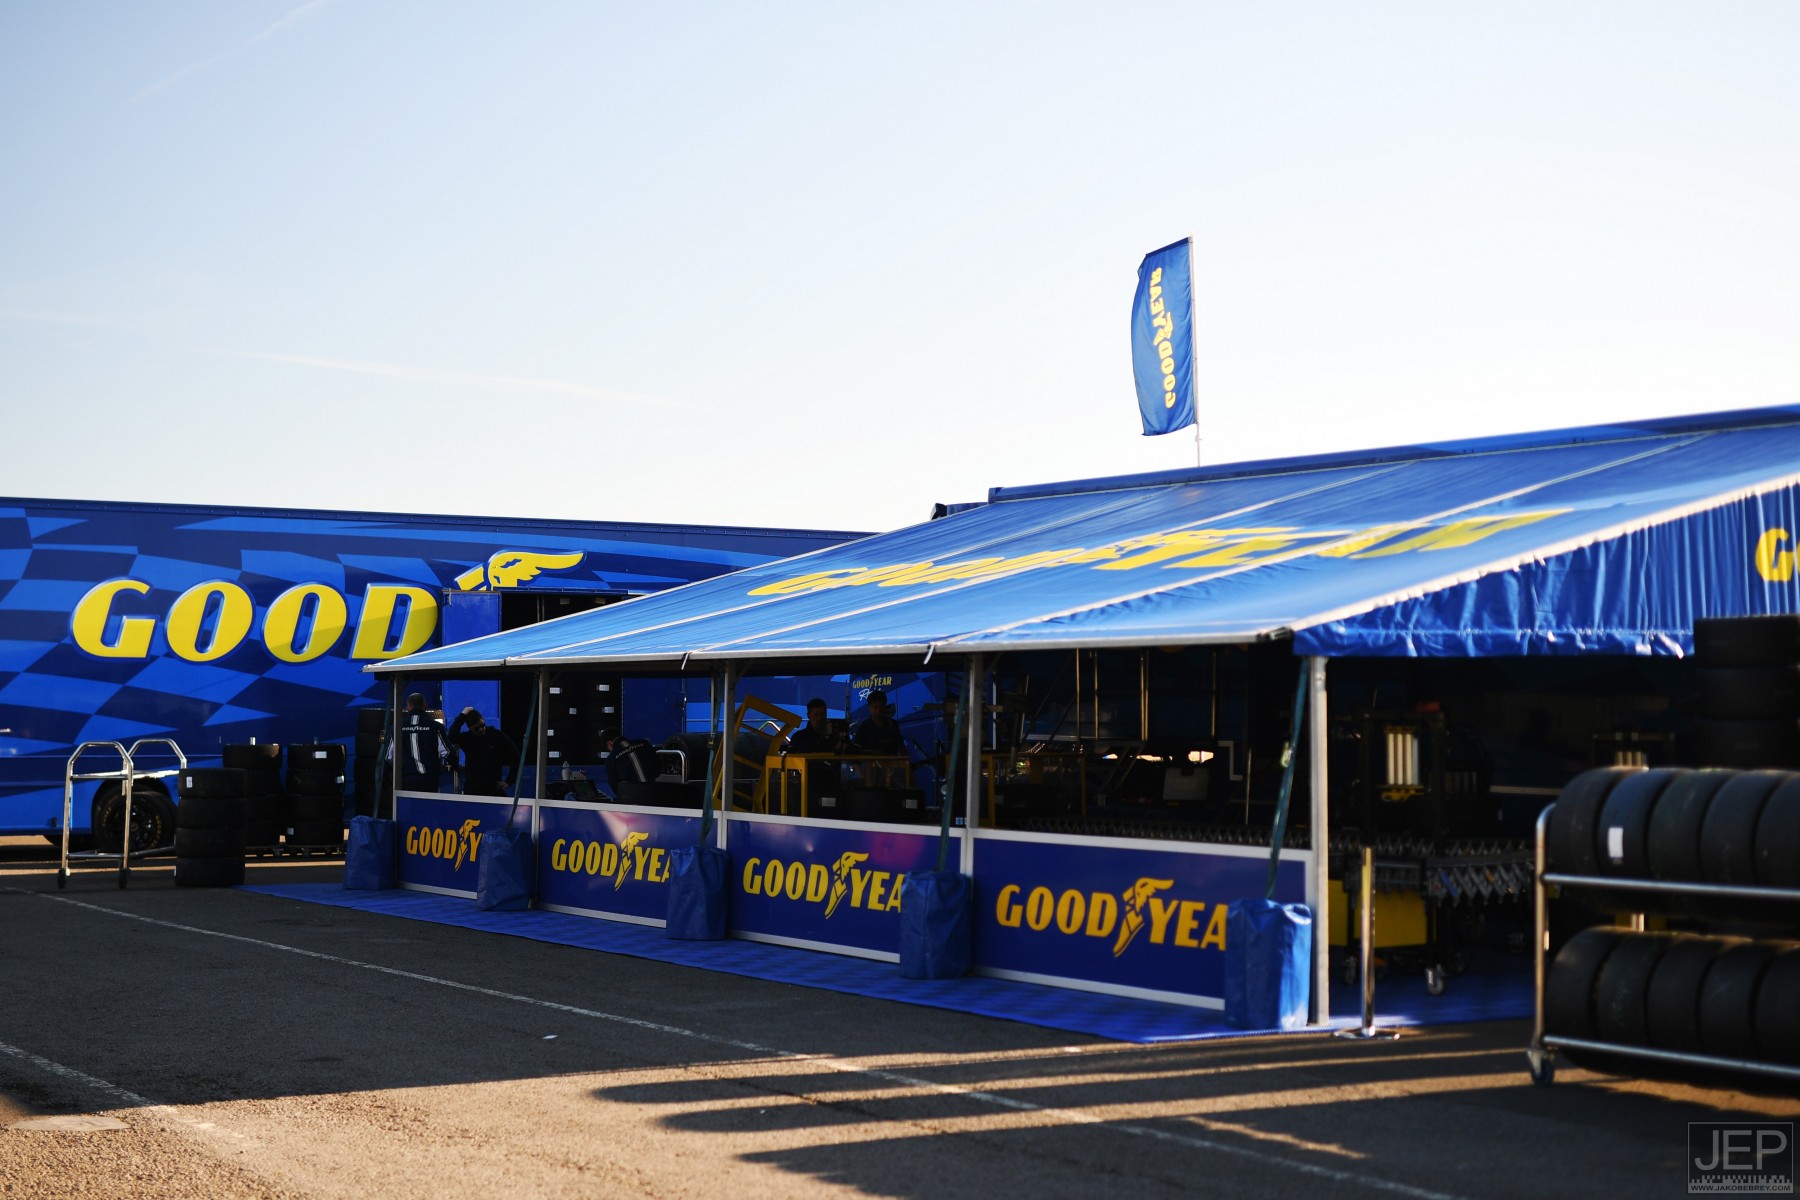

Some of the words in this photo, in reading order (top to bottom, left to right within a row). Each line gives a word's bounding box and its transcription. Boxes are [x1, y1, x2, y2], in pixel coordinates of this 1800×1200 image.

[1755, 528, 1800, 582] G
[71, 578, 440, 664] GOOD
[853, 676, 892, 689] GOODYEAR
